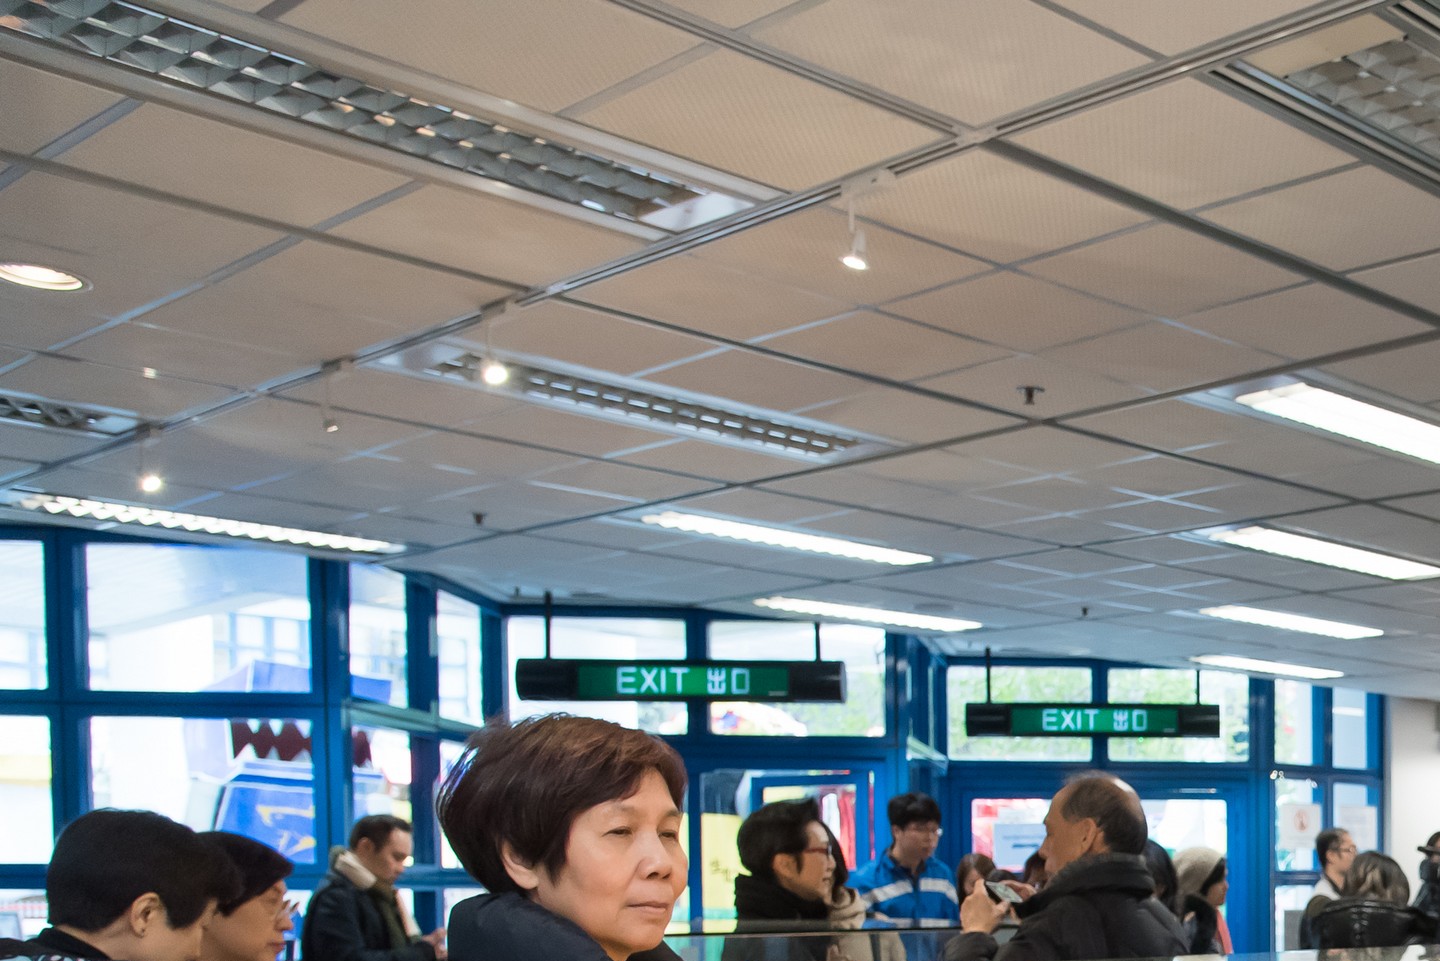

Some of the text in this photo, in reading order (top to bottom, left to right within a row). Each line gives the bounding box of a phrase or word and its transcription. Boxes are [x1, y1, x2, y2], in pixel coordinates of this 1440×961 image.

[616, 666, 750, 695] EXIT 出口
[1042, 708, 1147, 731] EXIT 出口
